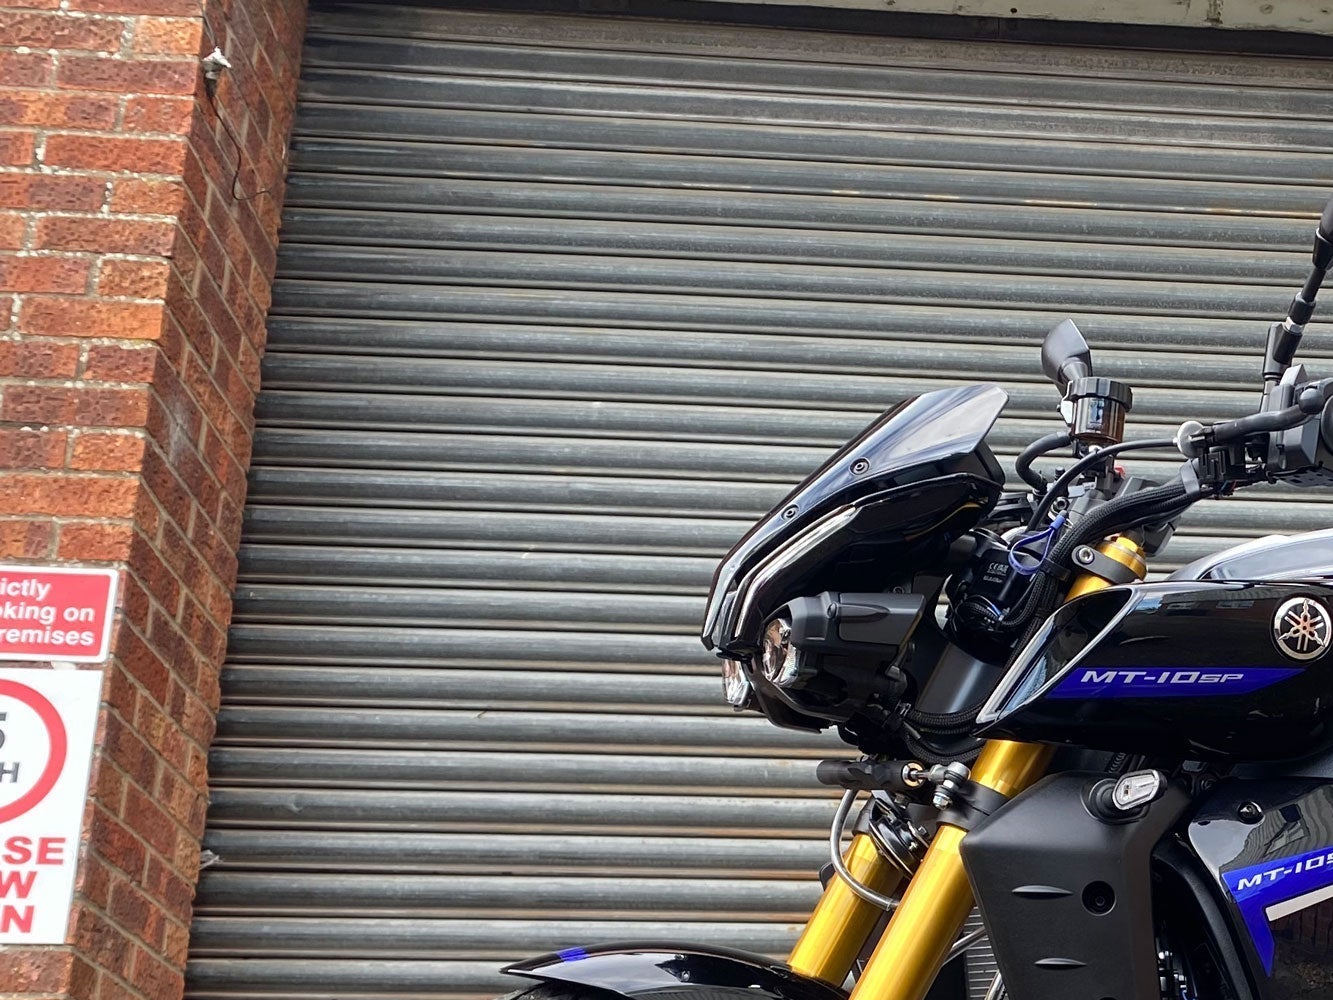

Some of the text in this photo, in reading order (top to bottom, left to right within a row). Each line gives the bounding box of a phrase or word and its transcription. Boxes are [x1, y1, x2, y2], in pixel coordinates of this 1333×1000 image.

[0, 601, 95, 625] king on
[2, 835, 66, 865] SE
[0, 905, 35, 933] N
